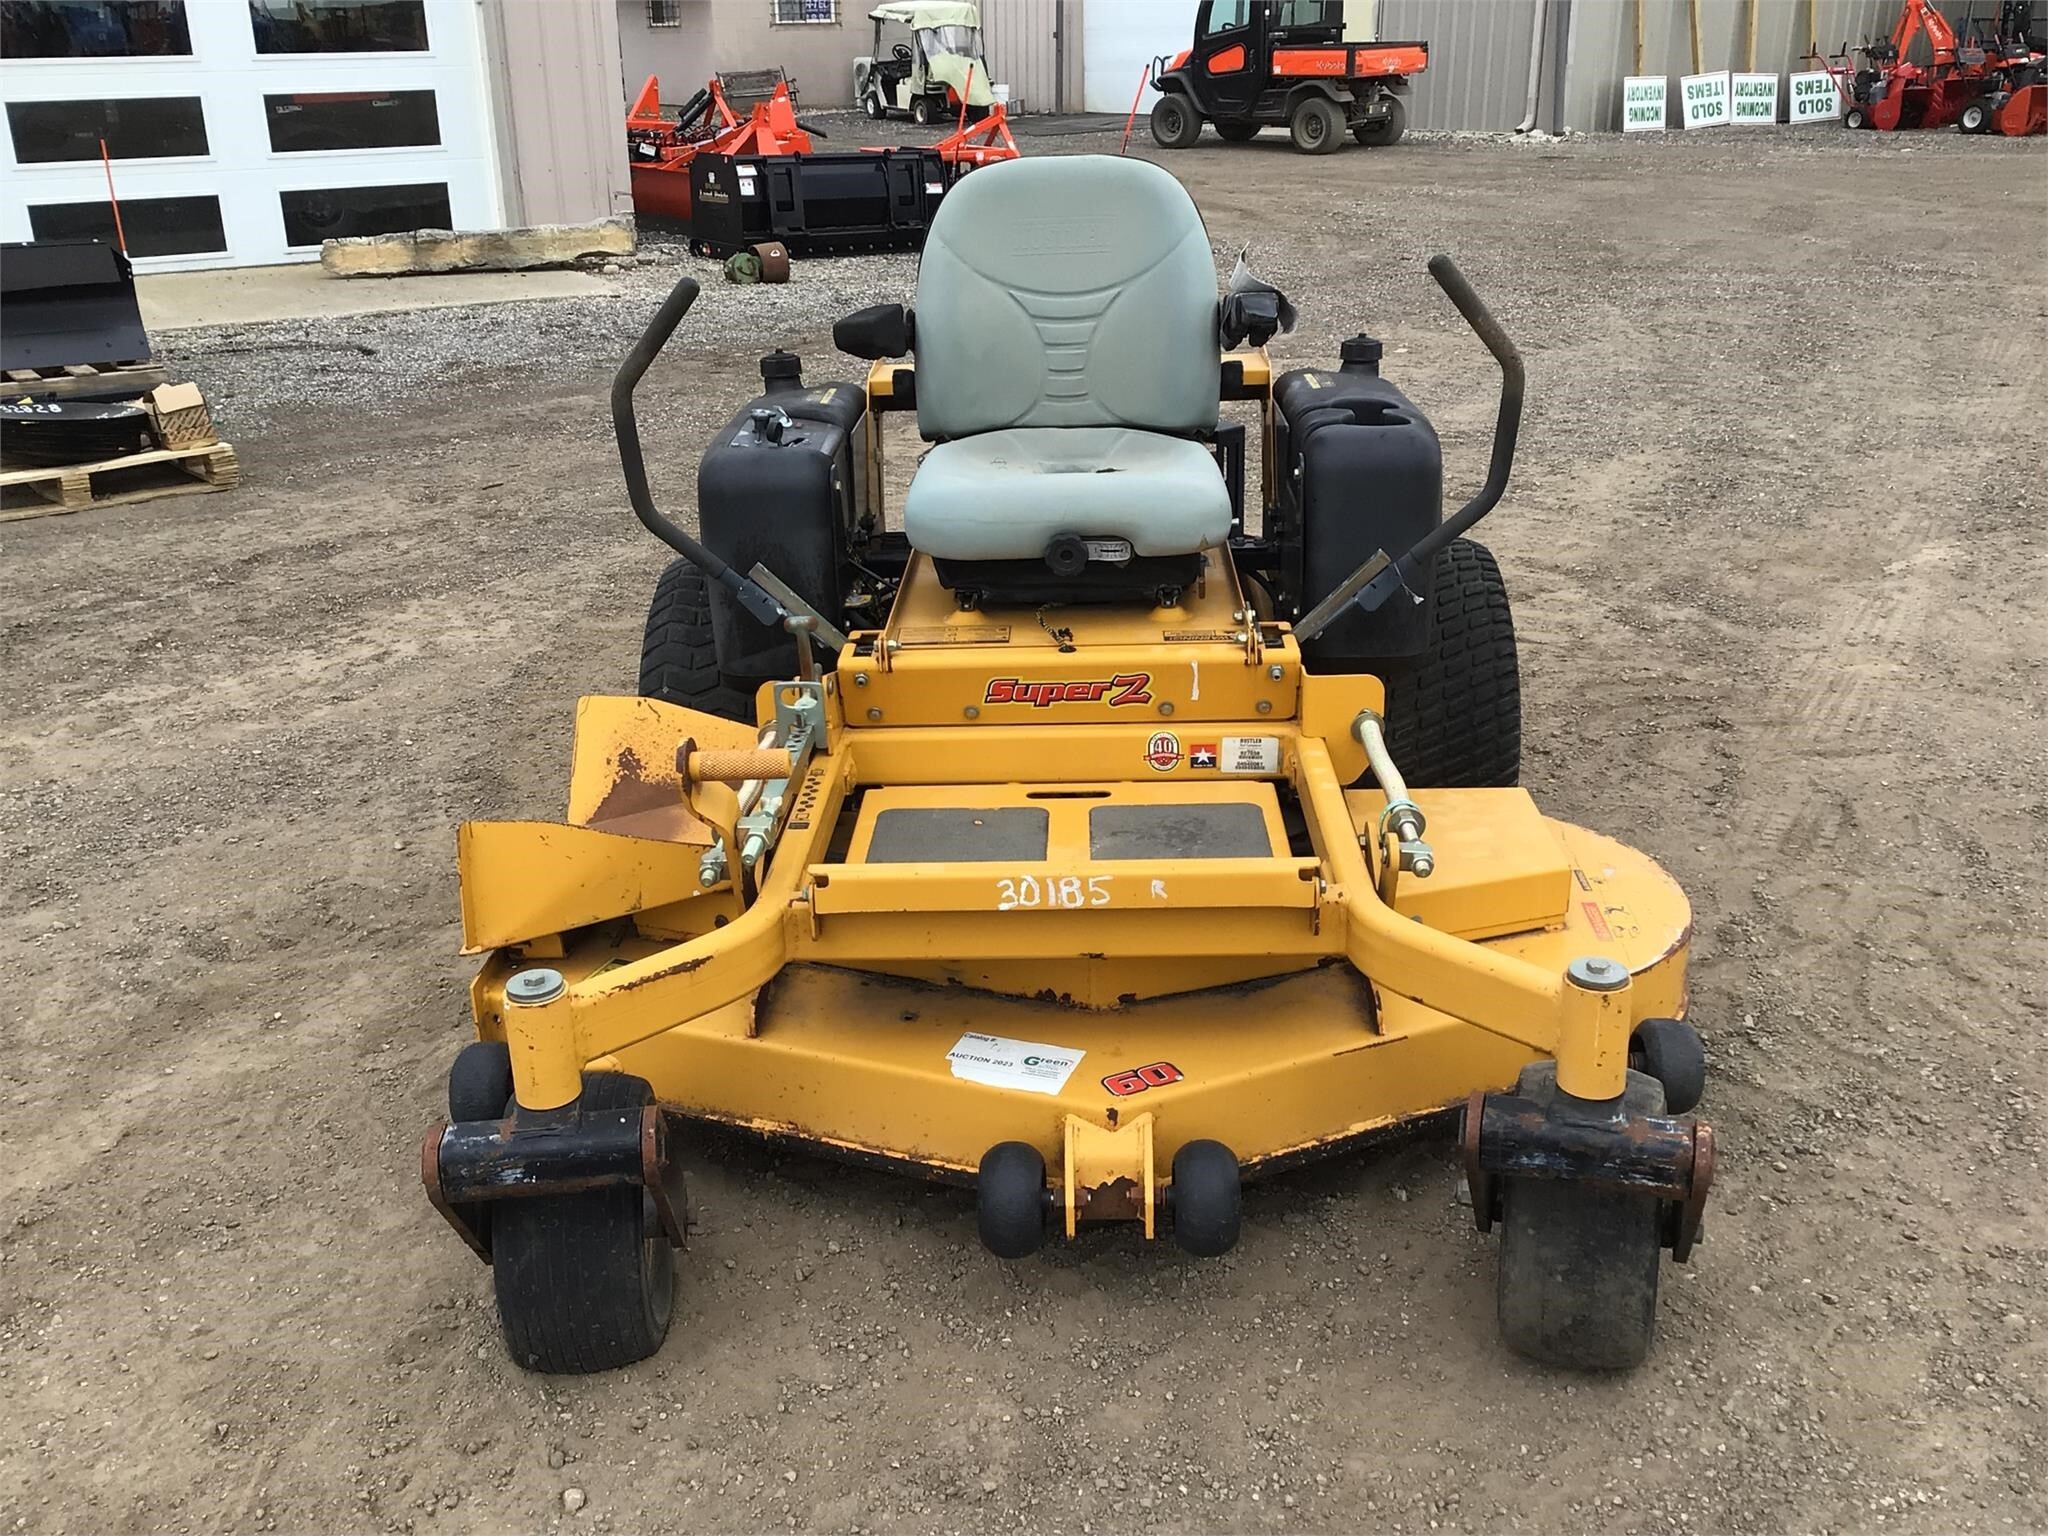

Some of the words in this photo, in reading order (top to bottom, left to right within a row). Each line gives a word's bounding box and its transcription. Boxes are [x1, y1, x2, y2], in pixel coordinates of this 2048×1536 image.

[1627, 85, 1664, 102] INVENTORY
[1687, 80, 1725, 100] ITEMS
[1735, 82, 1776, 97] INVENTORY
[1796, 79, 1835, 96] ITEMS
[1629, 106, 1662, 122] INCOMING
[1691, 101, 1723, 120] SOLD
[1736, 101, 1772, 117] INCOMING
[1798, 97, 1833, 115] SOLD
[1155, 739, 1172, 753] 40
[996, 875, 1114, 911] 30185
[949, 1052, 991, 1064] AUCTION
[992, 1059, 1014, 1068] 2023
[1023, 1056, 1069, 1067] Green
[1101, 1062, 1184, 1096] 60
